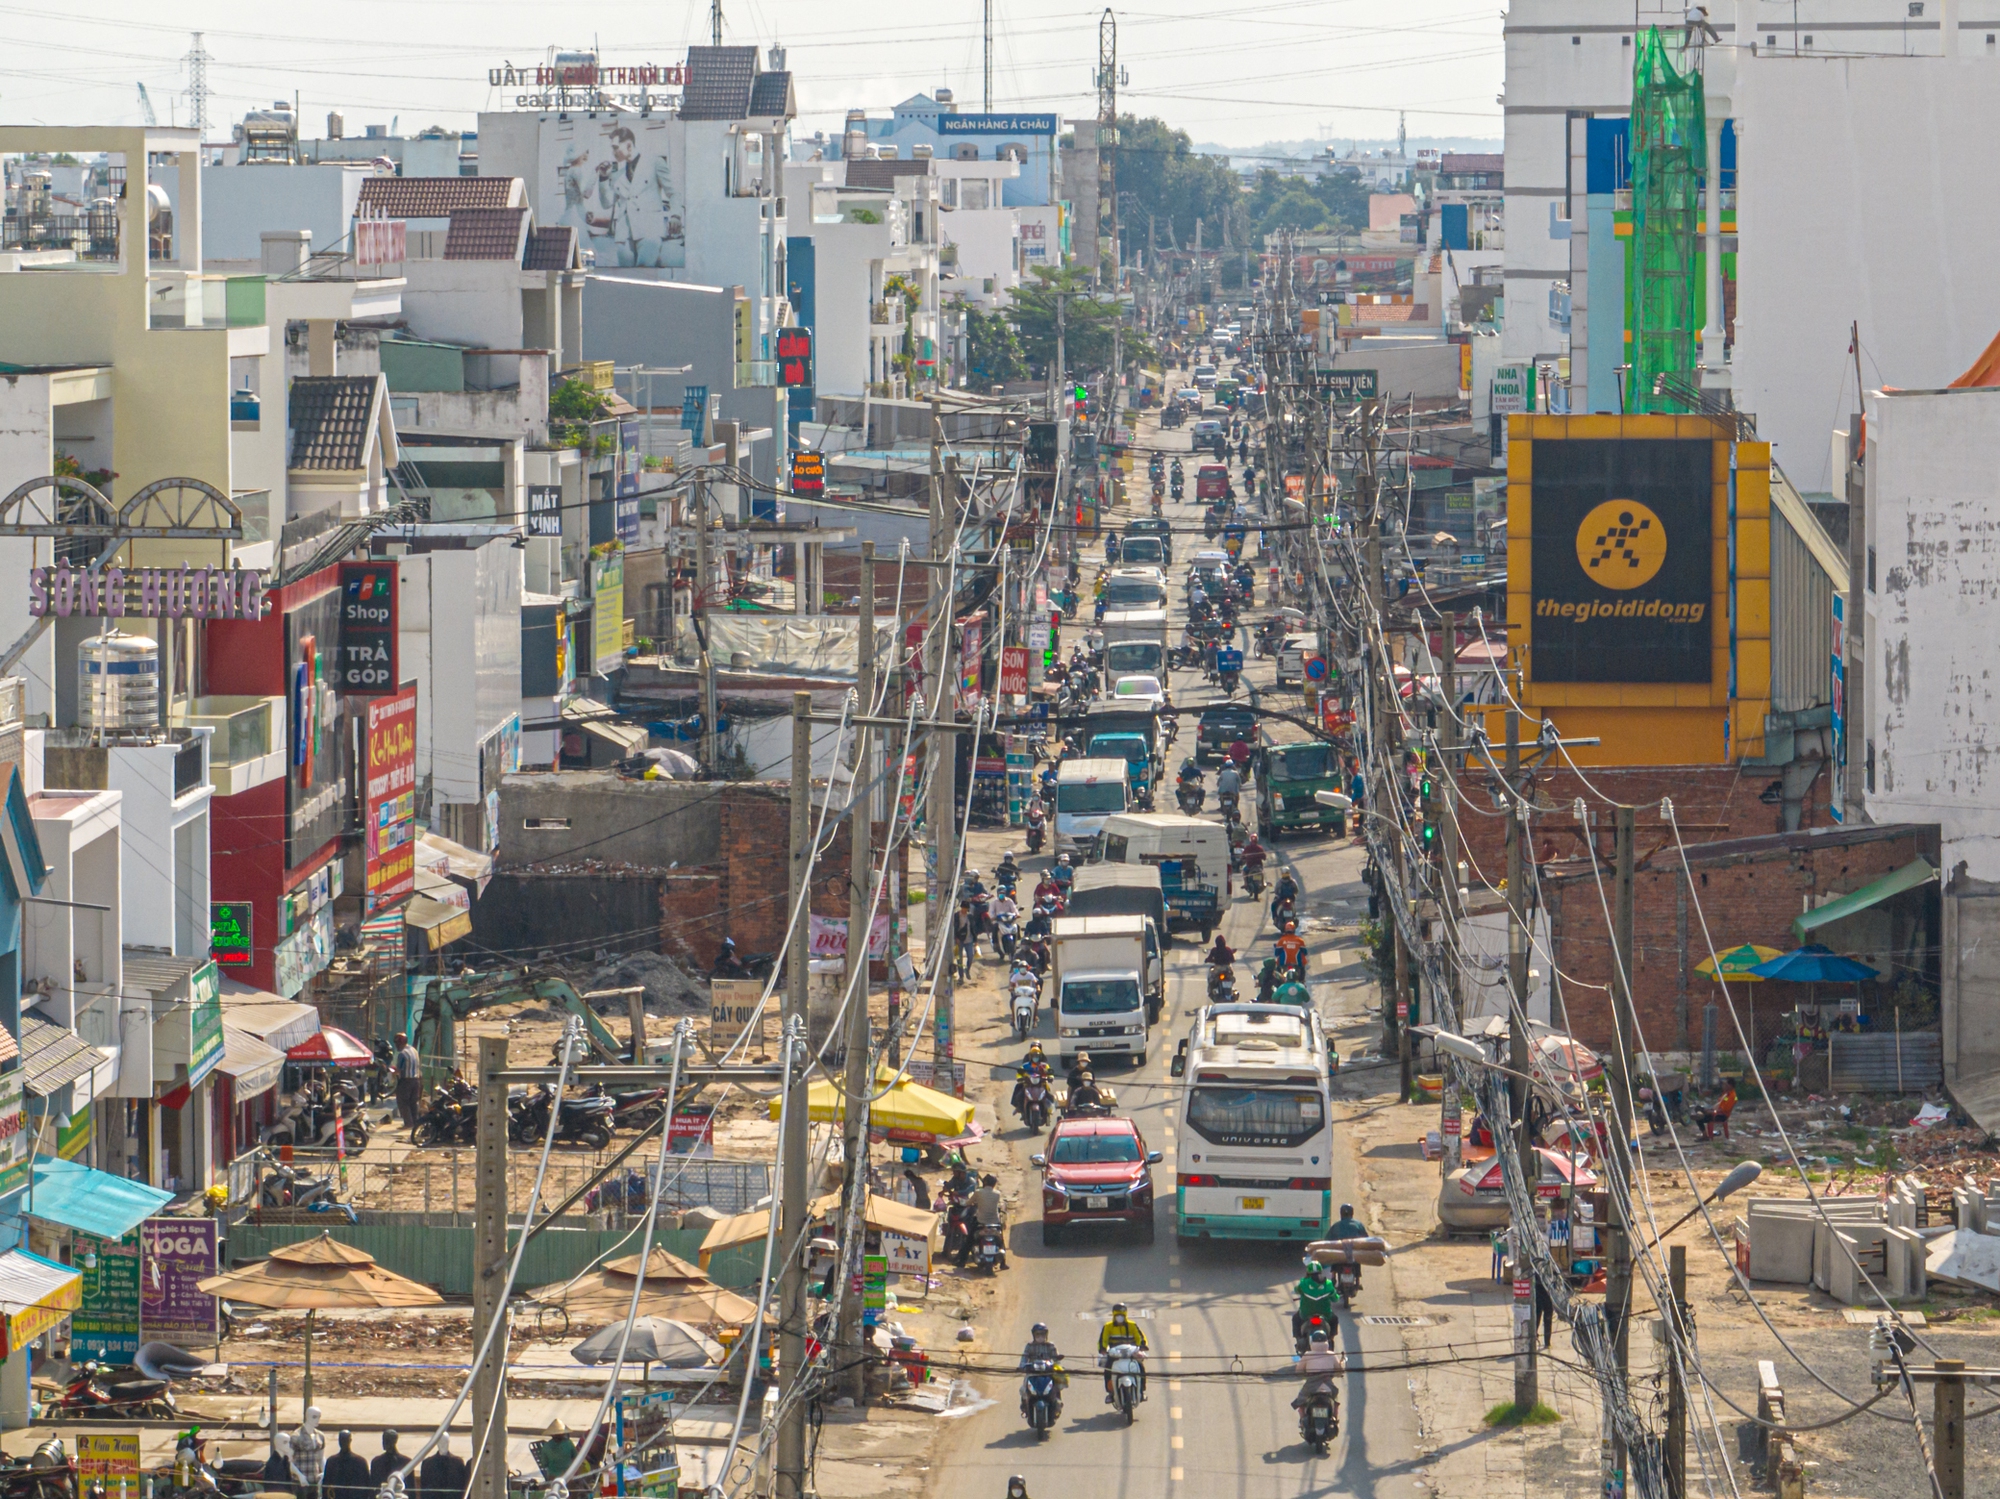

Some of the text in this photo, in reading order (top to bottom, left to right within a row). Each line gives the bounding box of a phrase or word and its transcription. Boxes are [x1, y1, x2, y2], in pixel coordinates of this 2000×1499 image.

[945, 119, 1050, 130] NGÂN HÀNG Á CHÂU
[1352, 374, 1373, 389] VIÊN
[1497, 368, 1518, 379] NHA
[1494, 384, 1520, 395] KHOA
[532, 488, 558, 511] MẮT
[30, 557, 261, 621] SÔNG HƯƠNG
[347, 604, 389, 622] Shop
[1536, 599, 1706, 623] thegioididong
[347, 640, 389, 661] TRẢ
[1004, 651, 1024, 669] SƠN
[347, 664, 389, 683] GÓP
[1222, 1136, 1288, 1145] UNIVERSE
[189, 1226, 206, 1235] Spa
[142, 1237, 210, 1255] YOGA
